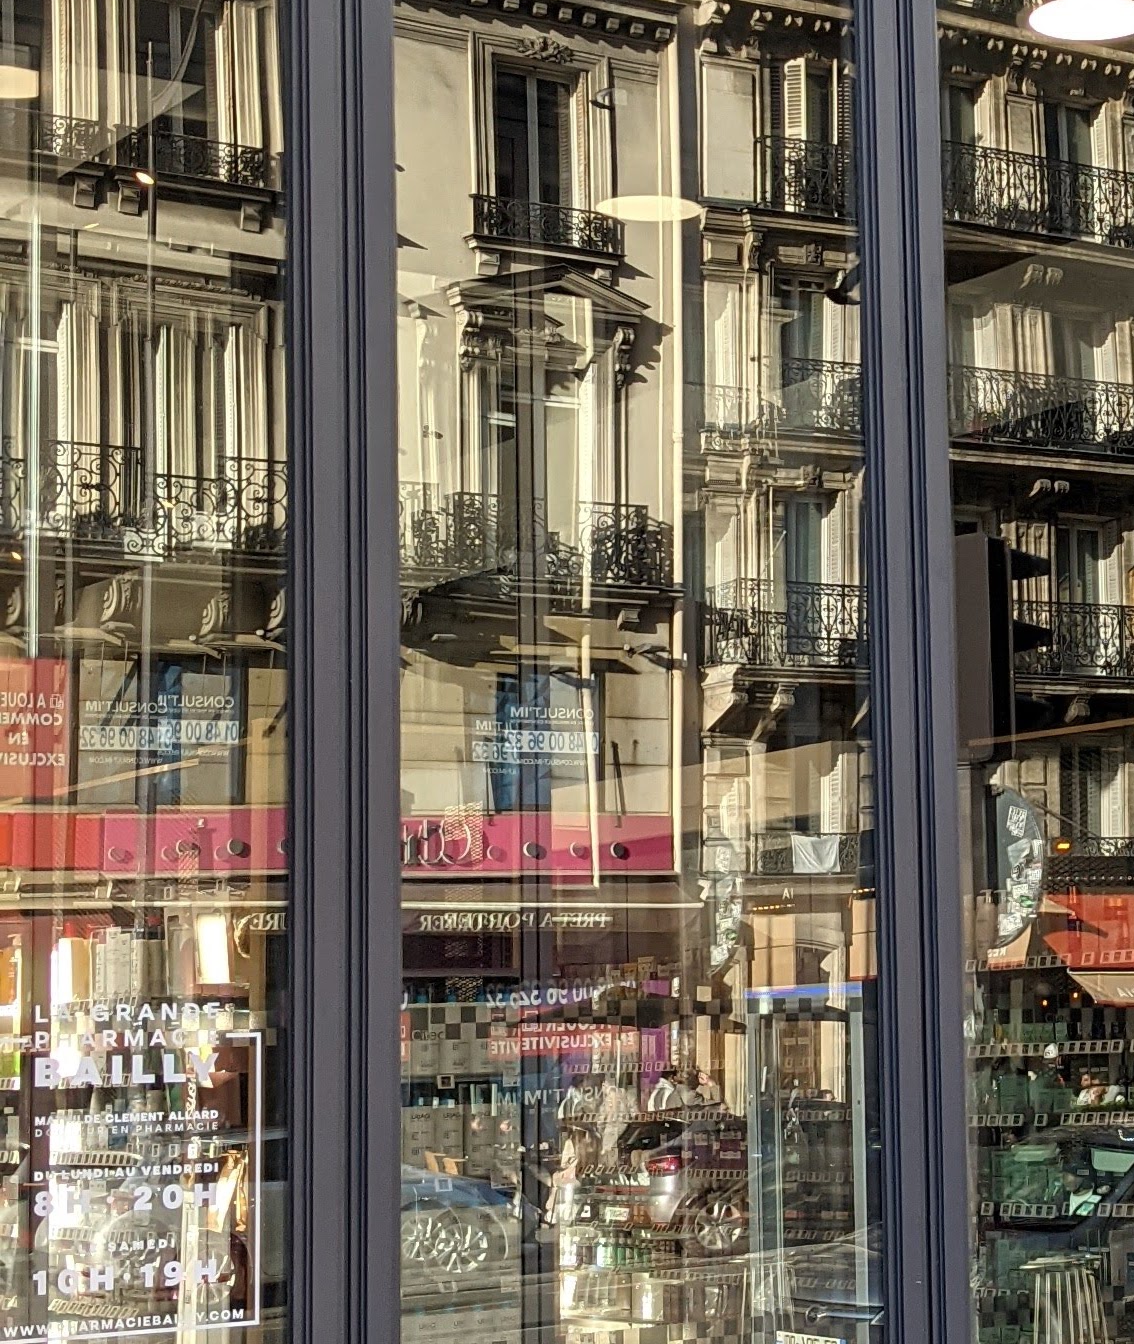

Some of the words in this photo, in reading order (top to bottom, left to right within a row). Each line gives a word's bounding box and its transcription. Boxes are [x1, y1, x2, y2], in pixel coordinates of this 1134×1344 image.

[35, 1005, 71, 1024] LA
[92, 1002, 221, 1022] GRANDE
[35, 1052, 220, 1087] BAILLY
[105, 1111, 165, 1123] CLEMENT
[169, 1109, 219, 1122] ALLARD
[111, 1123, 129, 1134] EN
[135, 1121, 219, 1134] PHARMACIE
[115, 1166, 136, 1178] AU
[141, 1163, 219, 1176] VENDREDI
[34, 1189, 90, 1217] 8H
[133, 1183, 218, 1211] 20H
[108, 1238, 176, 1252] SAMEDI
[33, 1265, 115, 1296] 10H
[141, 1258, 218, 1288] 19H
